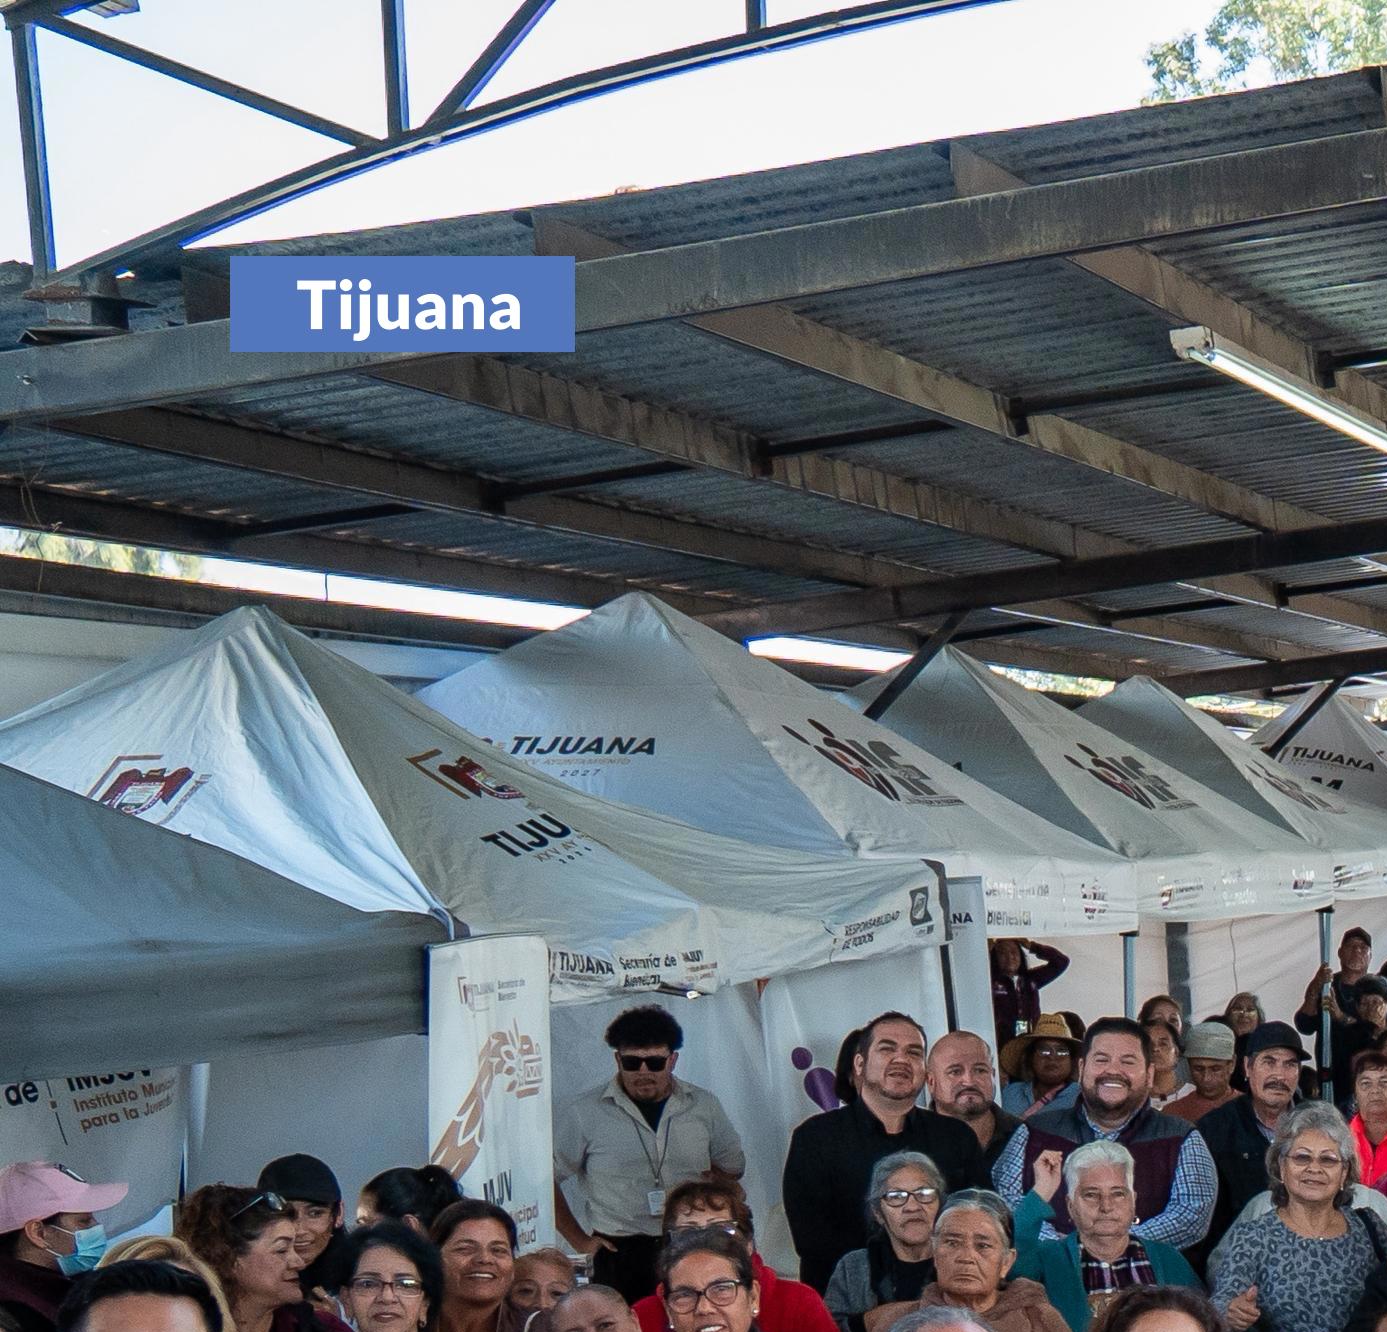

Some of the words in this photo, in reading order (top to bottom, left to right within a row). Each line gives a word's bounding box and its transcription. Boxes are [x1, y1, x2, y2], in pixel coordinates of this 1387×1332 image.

[510, 736, 656, 755] TIJUANA
[1293, 746, 1375, 772] TIJUANA
[480, 813, 572, 857] TIJU
[844, 911, 900, 936] RESPONSABILIDAD
[558, 951, 615, 975] TIJUANA
[73, 1088, 138, 1112] Instituto
[80, 1112, 120, 1133] para
[123, 1107, 139, 1120] la
